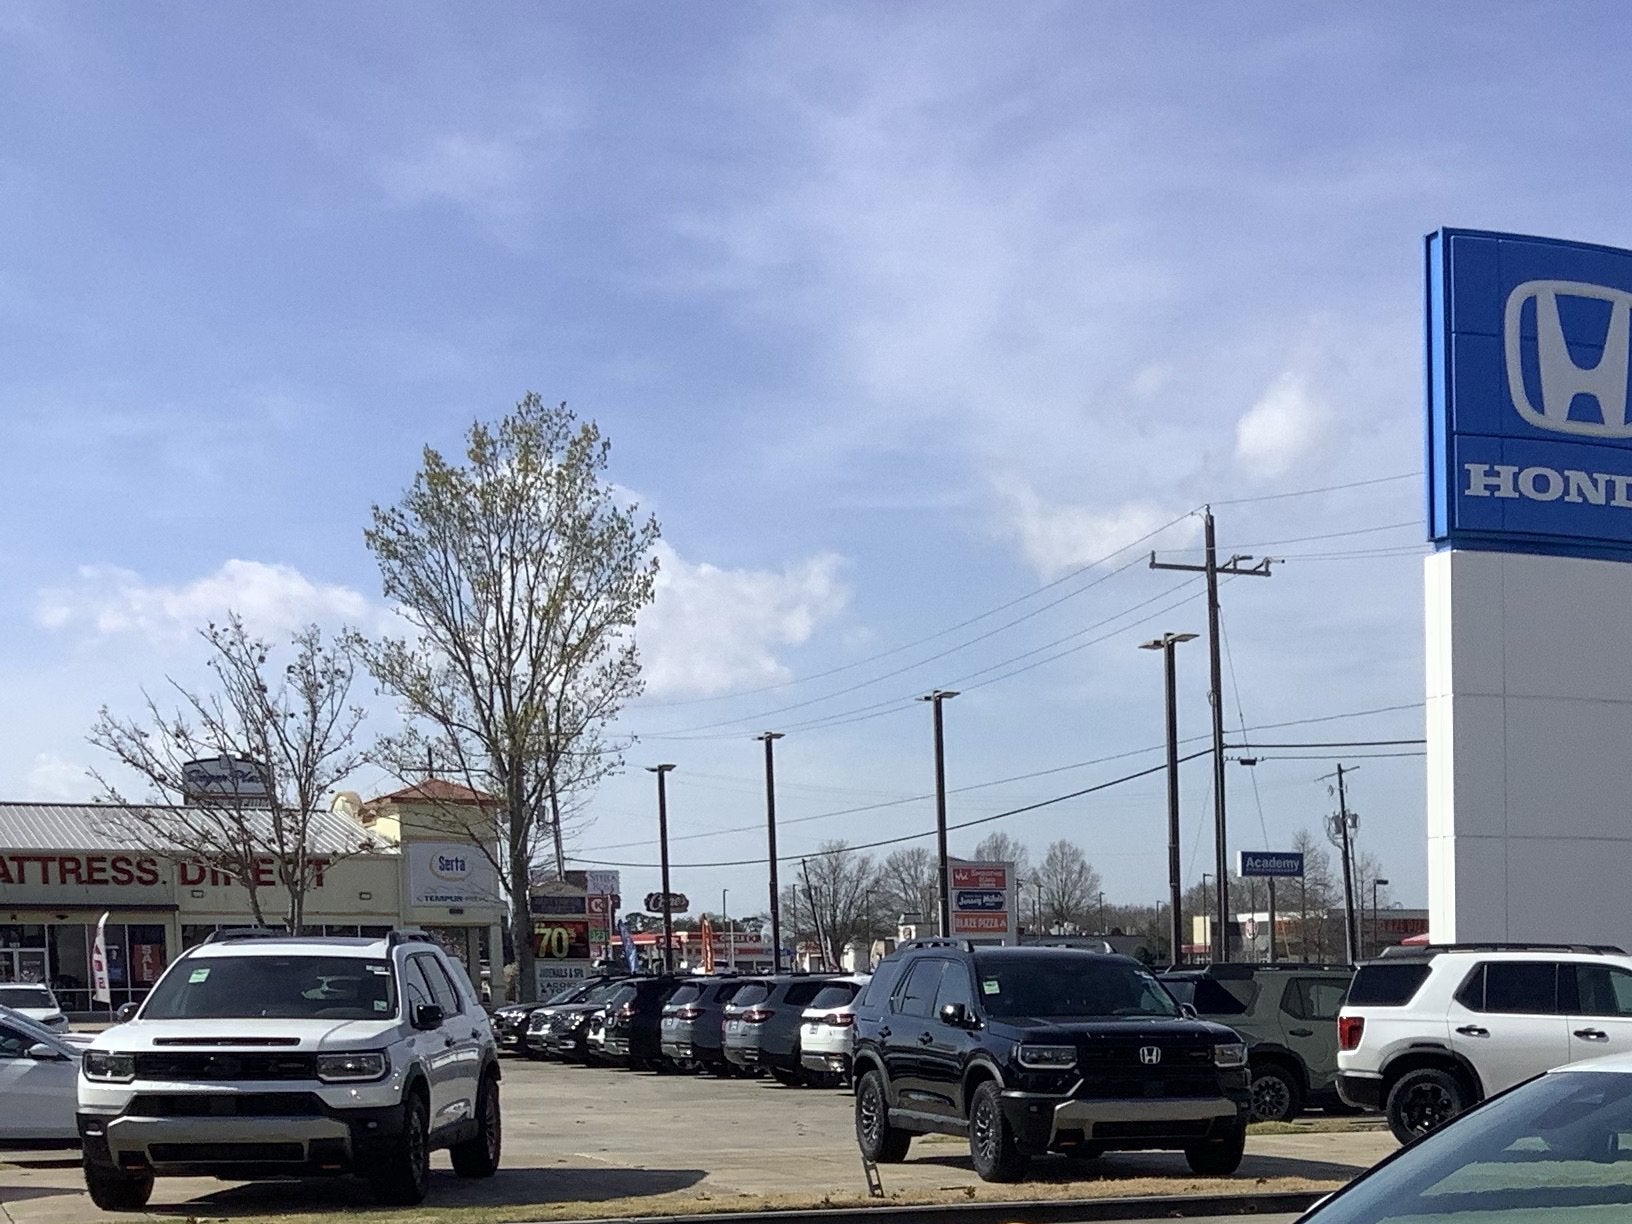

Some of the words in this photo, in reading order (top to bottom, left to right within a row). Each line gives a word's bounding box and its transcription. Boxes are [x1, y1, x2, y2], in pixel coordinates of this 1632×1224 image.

[438, 856, 466, 871] Serta
[1246, 857, 1300, 872] Academy
[978, 918, 999, 929] PIZZA
